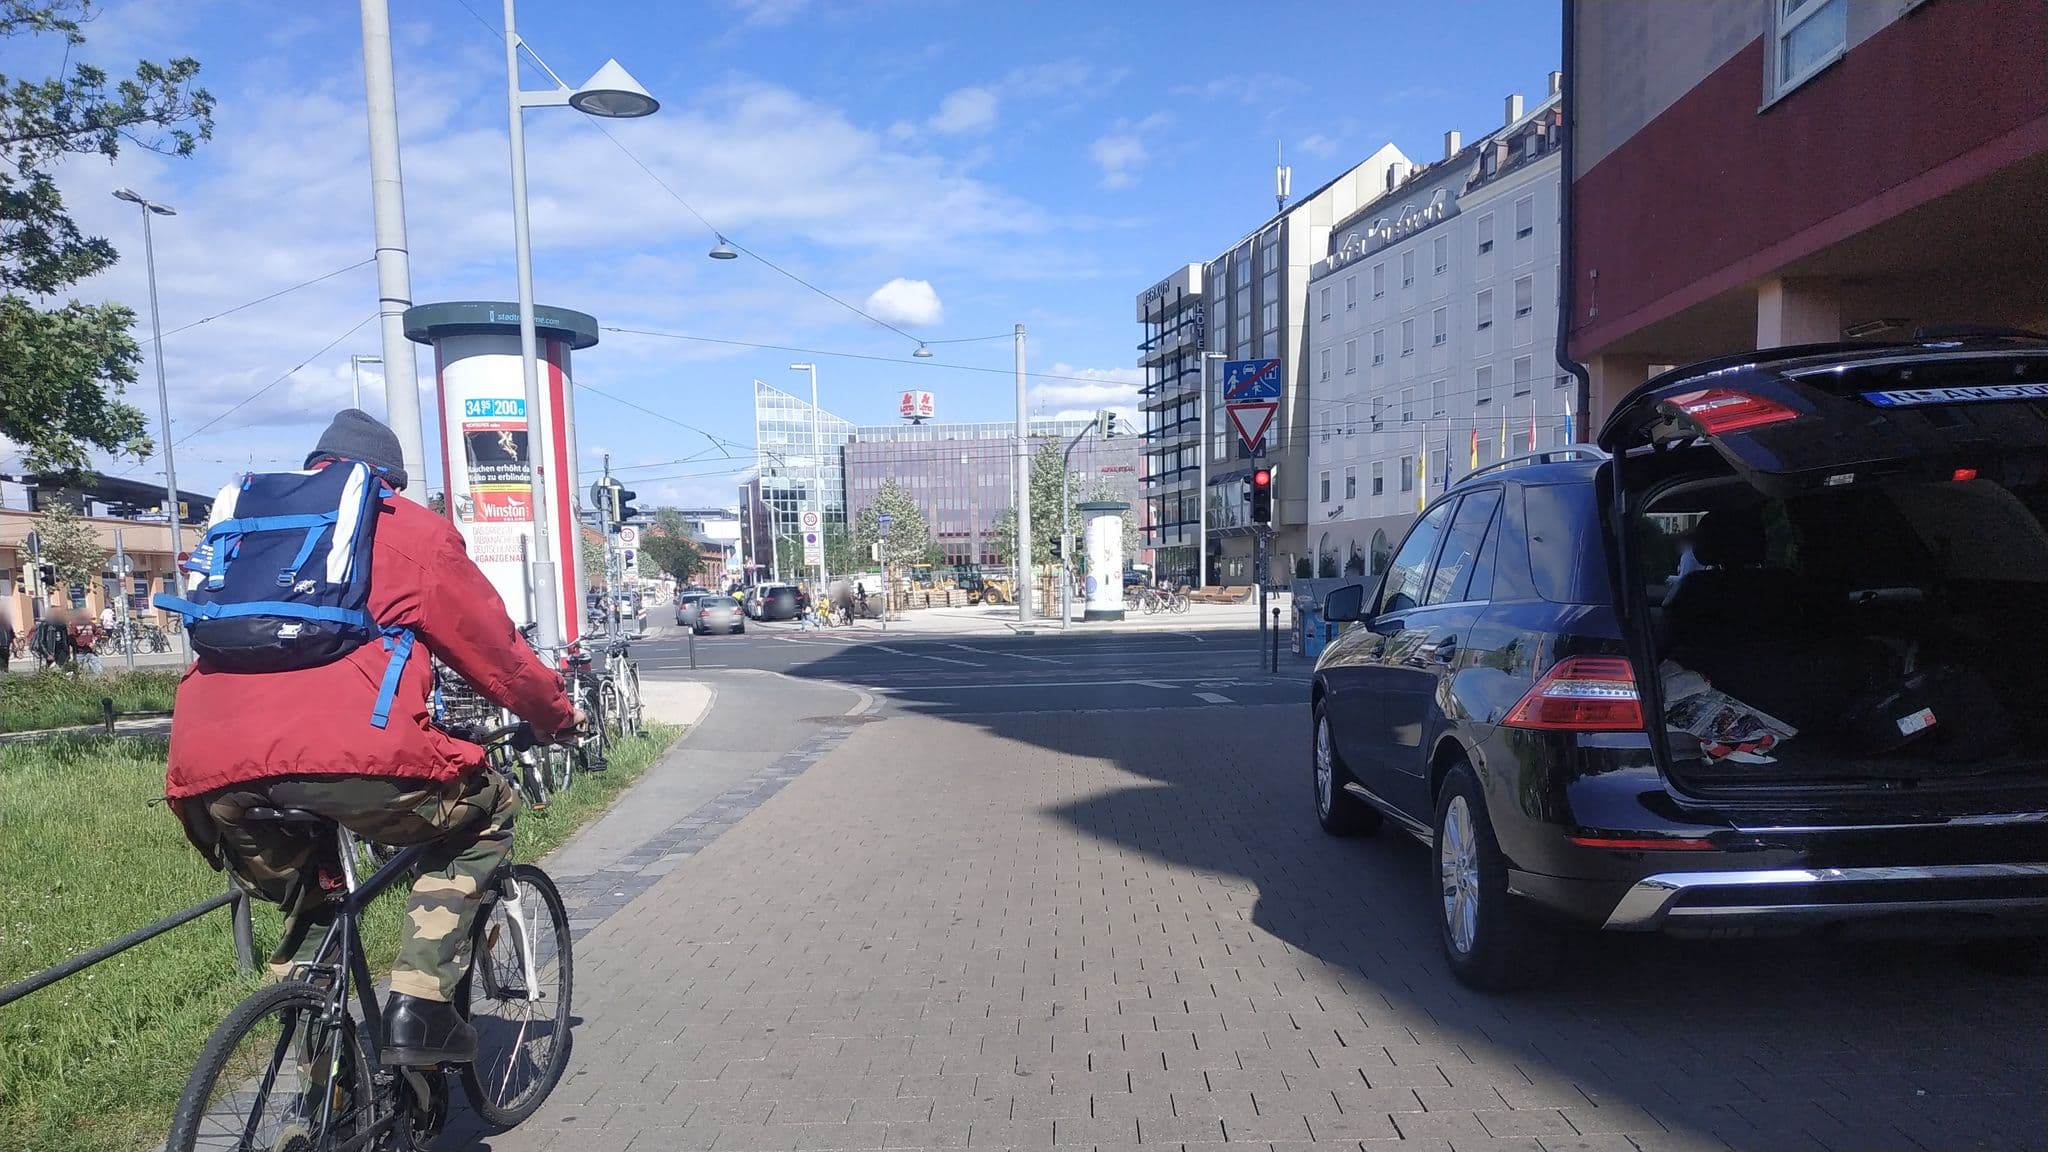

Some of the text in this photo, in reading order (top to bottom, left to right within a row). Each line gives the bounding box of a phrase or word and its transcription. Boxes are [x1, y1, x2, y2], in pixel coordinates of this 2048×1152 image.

[497, 312, 560, 325] stadtrme.com
[1889, 391, 1921, 402] N
[494, 400, 517, 415] 200
[482, 503, 526, 517] Winston
